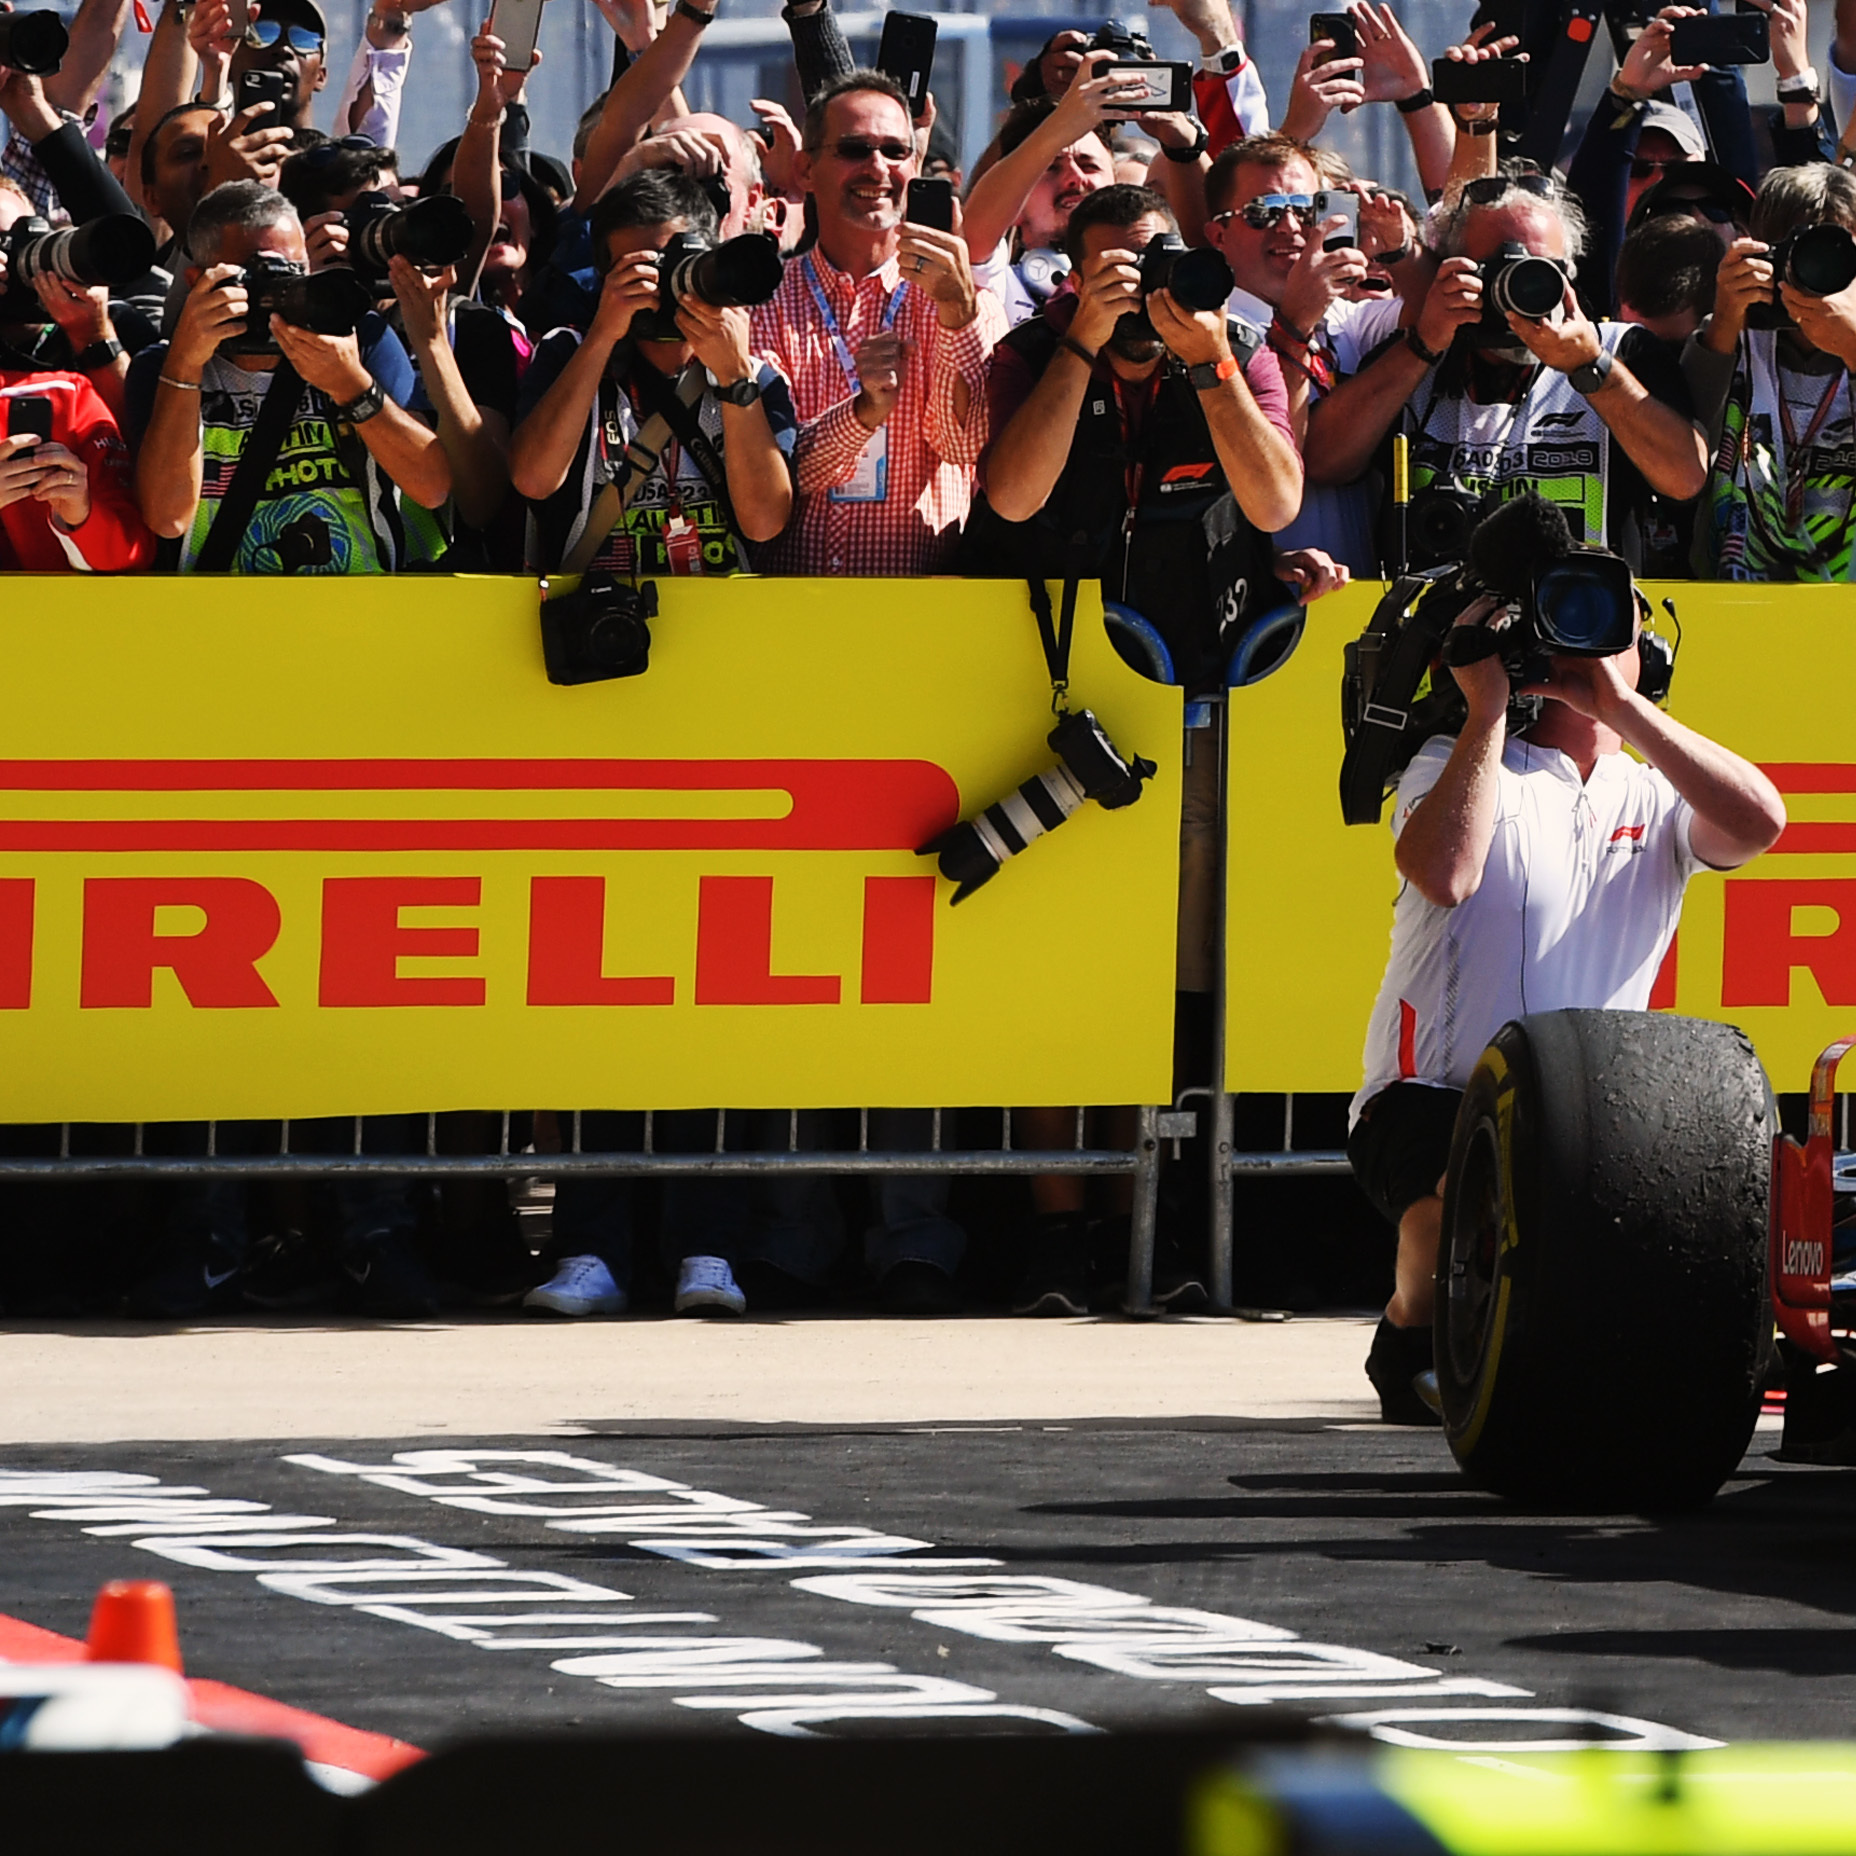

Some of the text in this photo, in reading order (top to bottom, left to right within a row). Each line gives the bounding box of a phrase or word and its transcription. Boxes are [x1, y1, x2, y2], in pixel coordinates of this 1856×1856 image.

[604, 409, 621, 445] EOS
[1532, 449, 1594, 466] 2018
[1782, 1229, 1824, 1276] Lenovo
